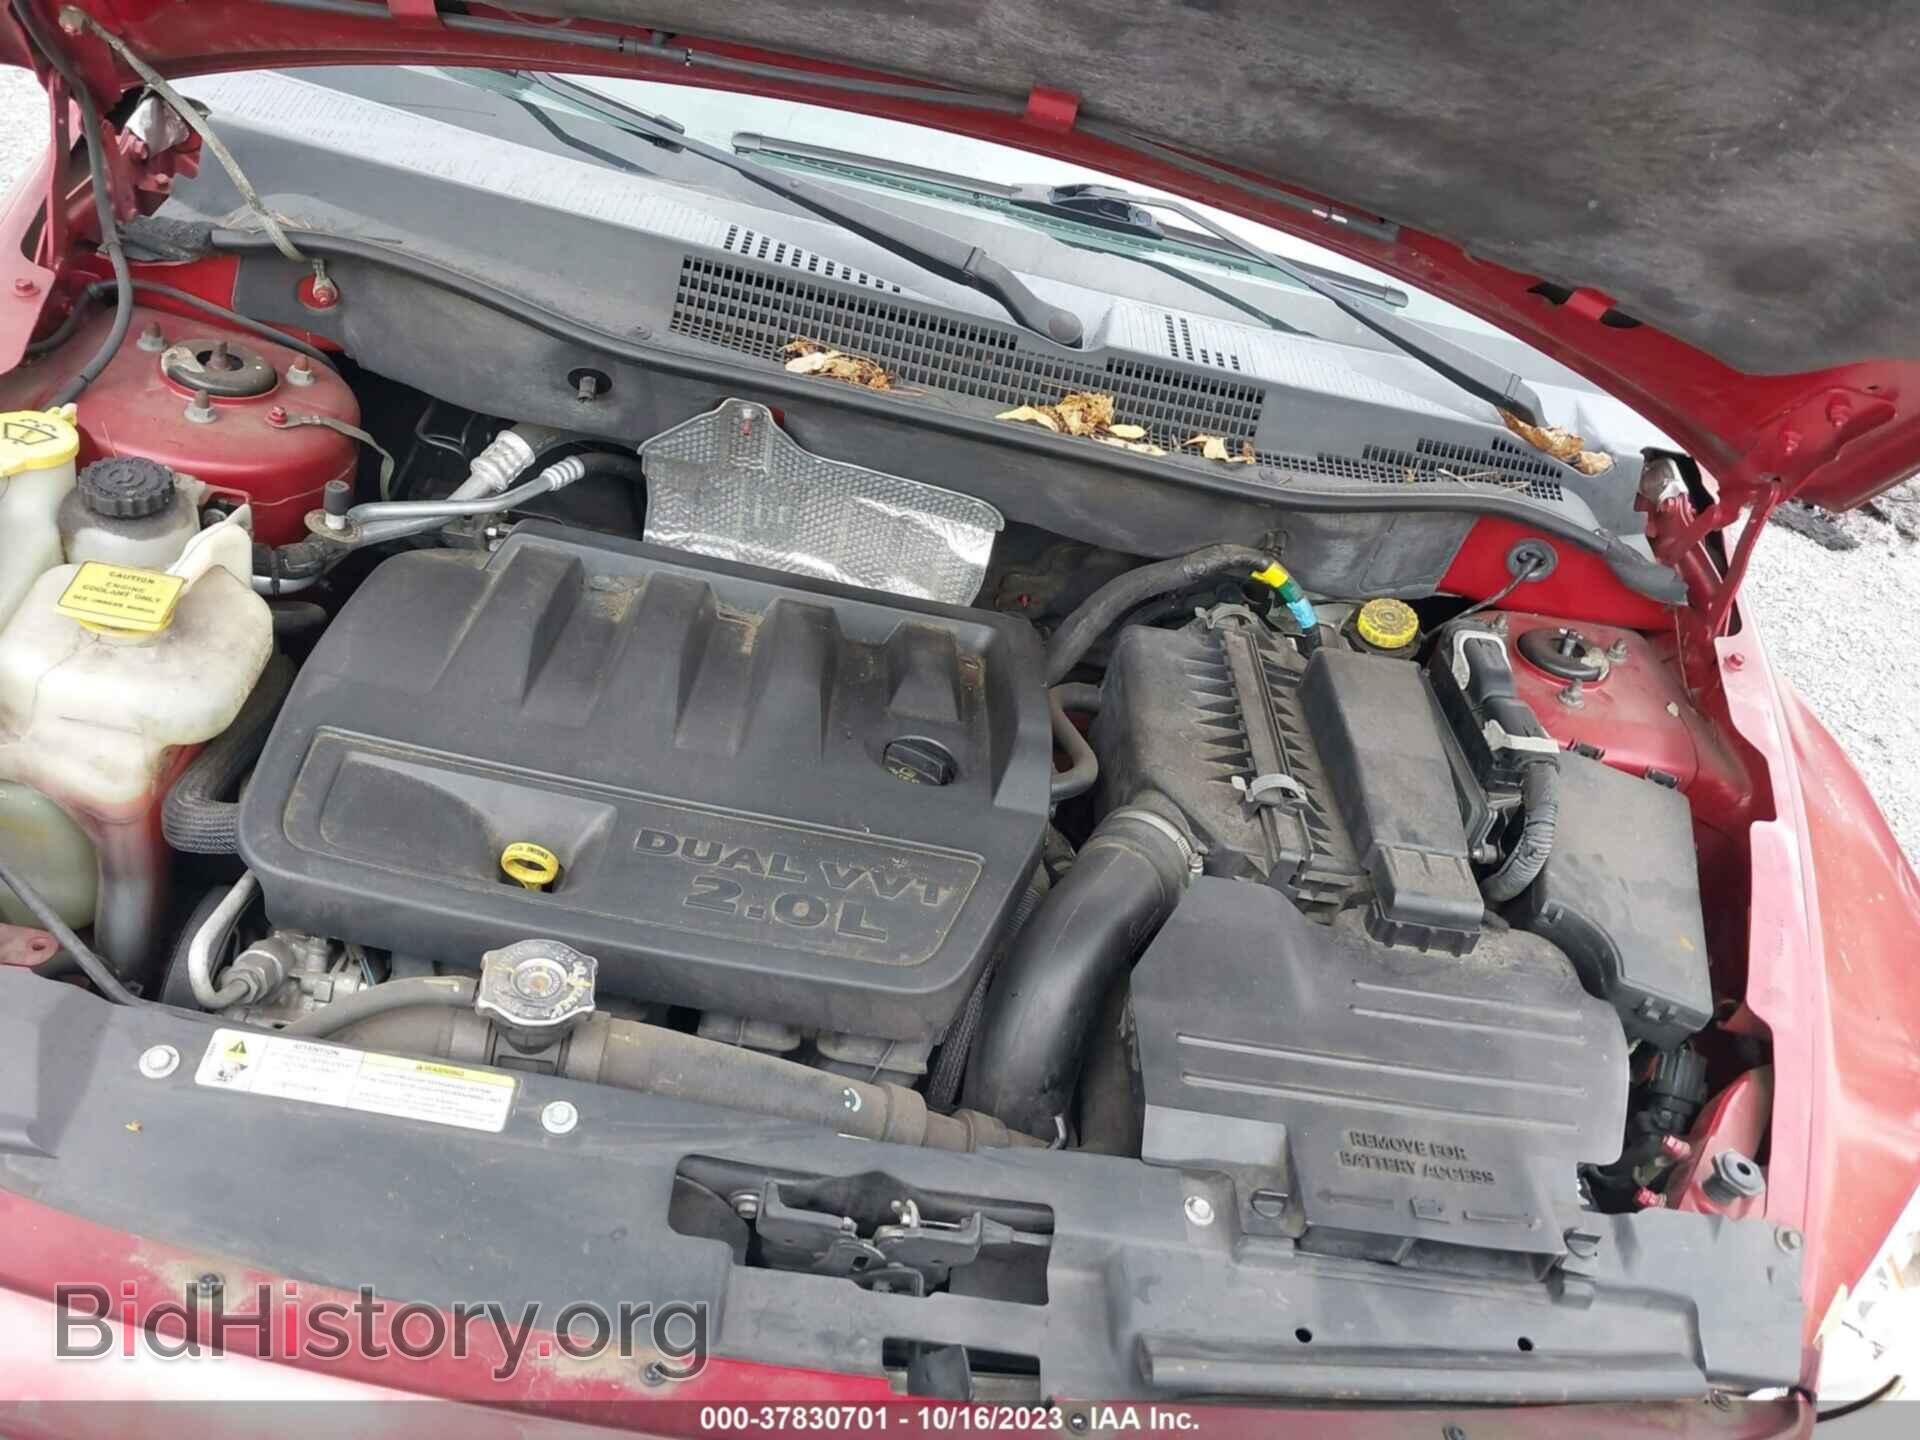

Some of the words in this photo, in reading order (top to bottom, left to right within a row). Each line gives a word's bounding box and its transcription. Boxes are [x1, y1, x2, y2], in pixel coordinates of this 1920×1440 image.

[108, 570, 156, 585] CAUTION
[633, 827, 808, 883] DUAL
[818, 859, 952, 907] VVT
[682, 874, 888, 943] 2.0L
[1348, 1130, 1426, 1157] REMOVE
[1428, 1141, 1467, 1161] FOR
[1338, 1151, 1417, 1176] BATTERY
[1422, 1162, 1496, 1185] ACCESS
